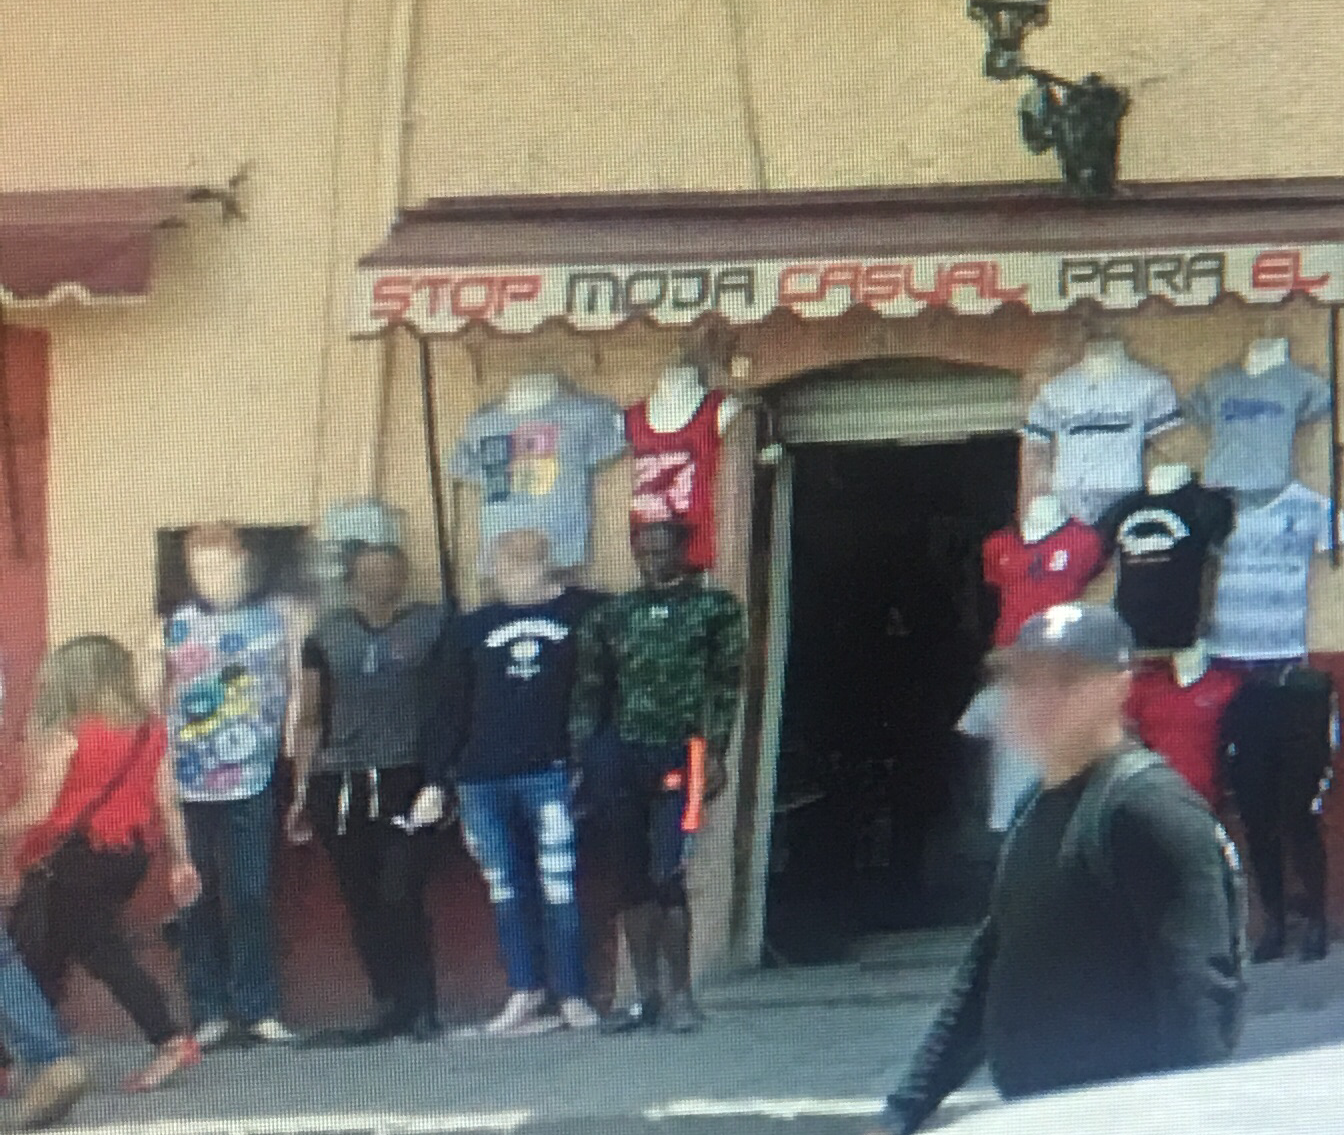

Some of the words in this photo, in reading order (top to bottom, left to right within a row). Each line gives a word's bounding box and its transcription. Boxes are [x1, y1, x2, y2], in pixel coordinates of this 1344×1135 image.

[371, 273, 542, 320] STOP
[566, 267, 756, 316] MODA
[779, 259, 1028, 308] CASUAL
[1060, 252, 1226, 299] PARA
[1252, 250, 1330, 290] EL
